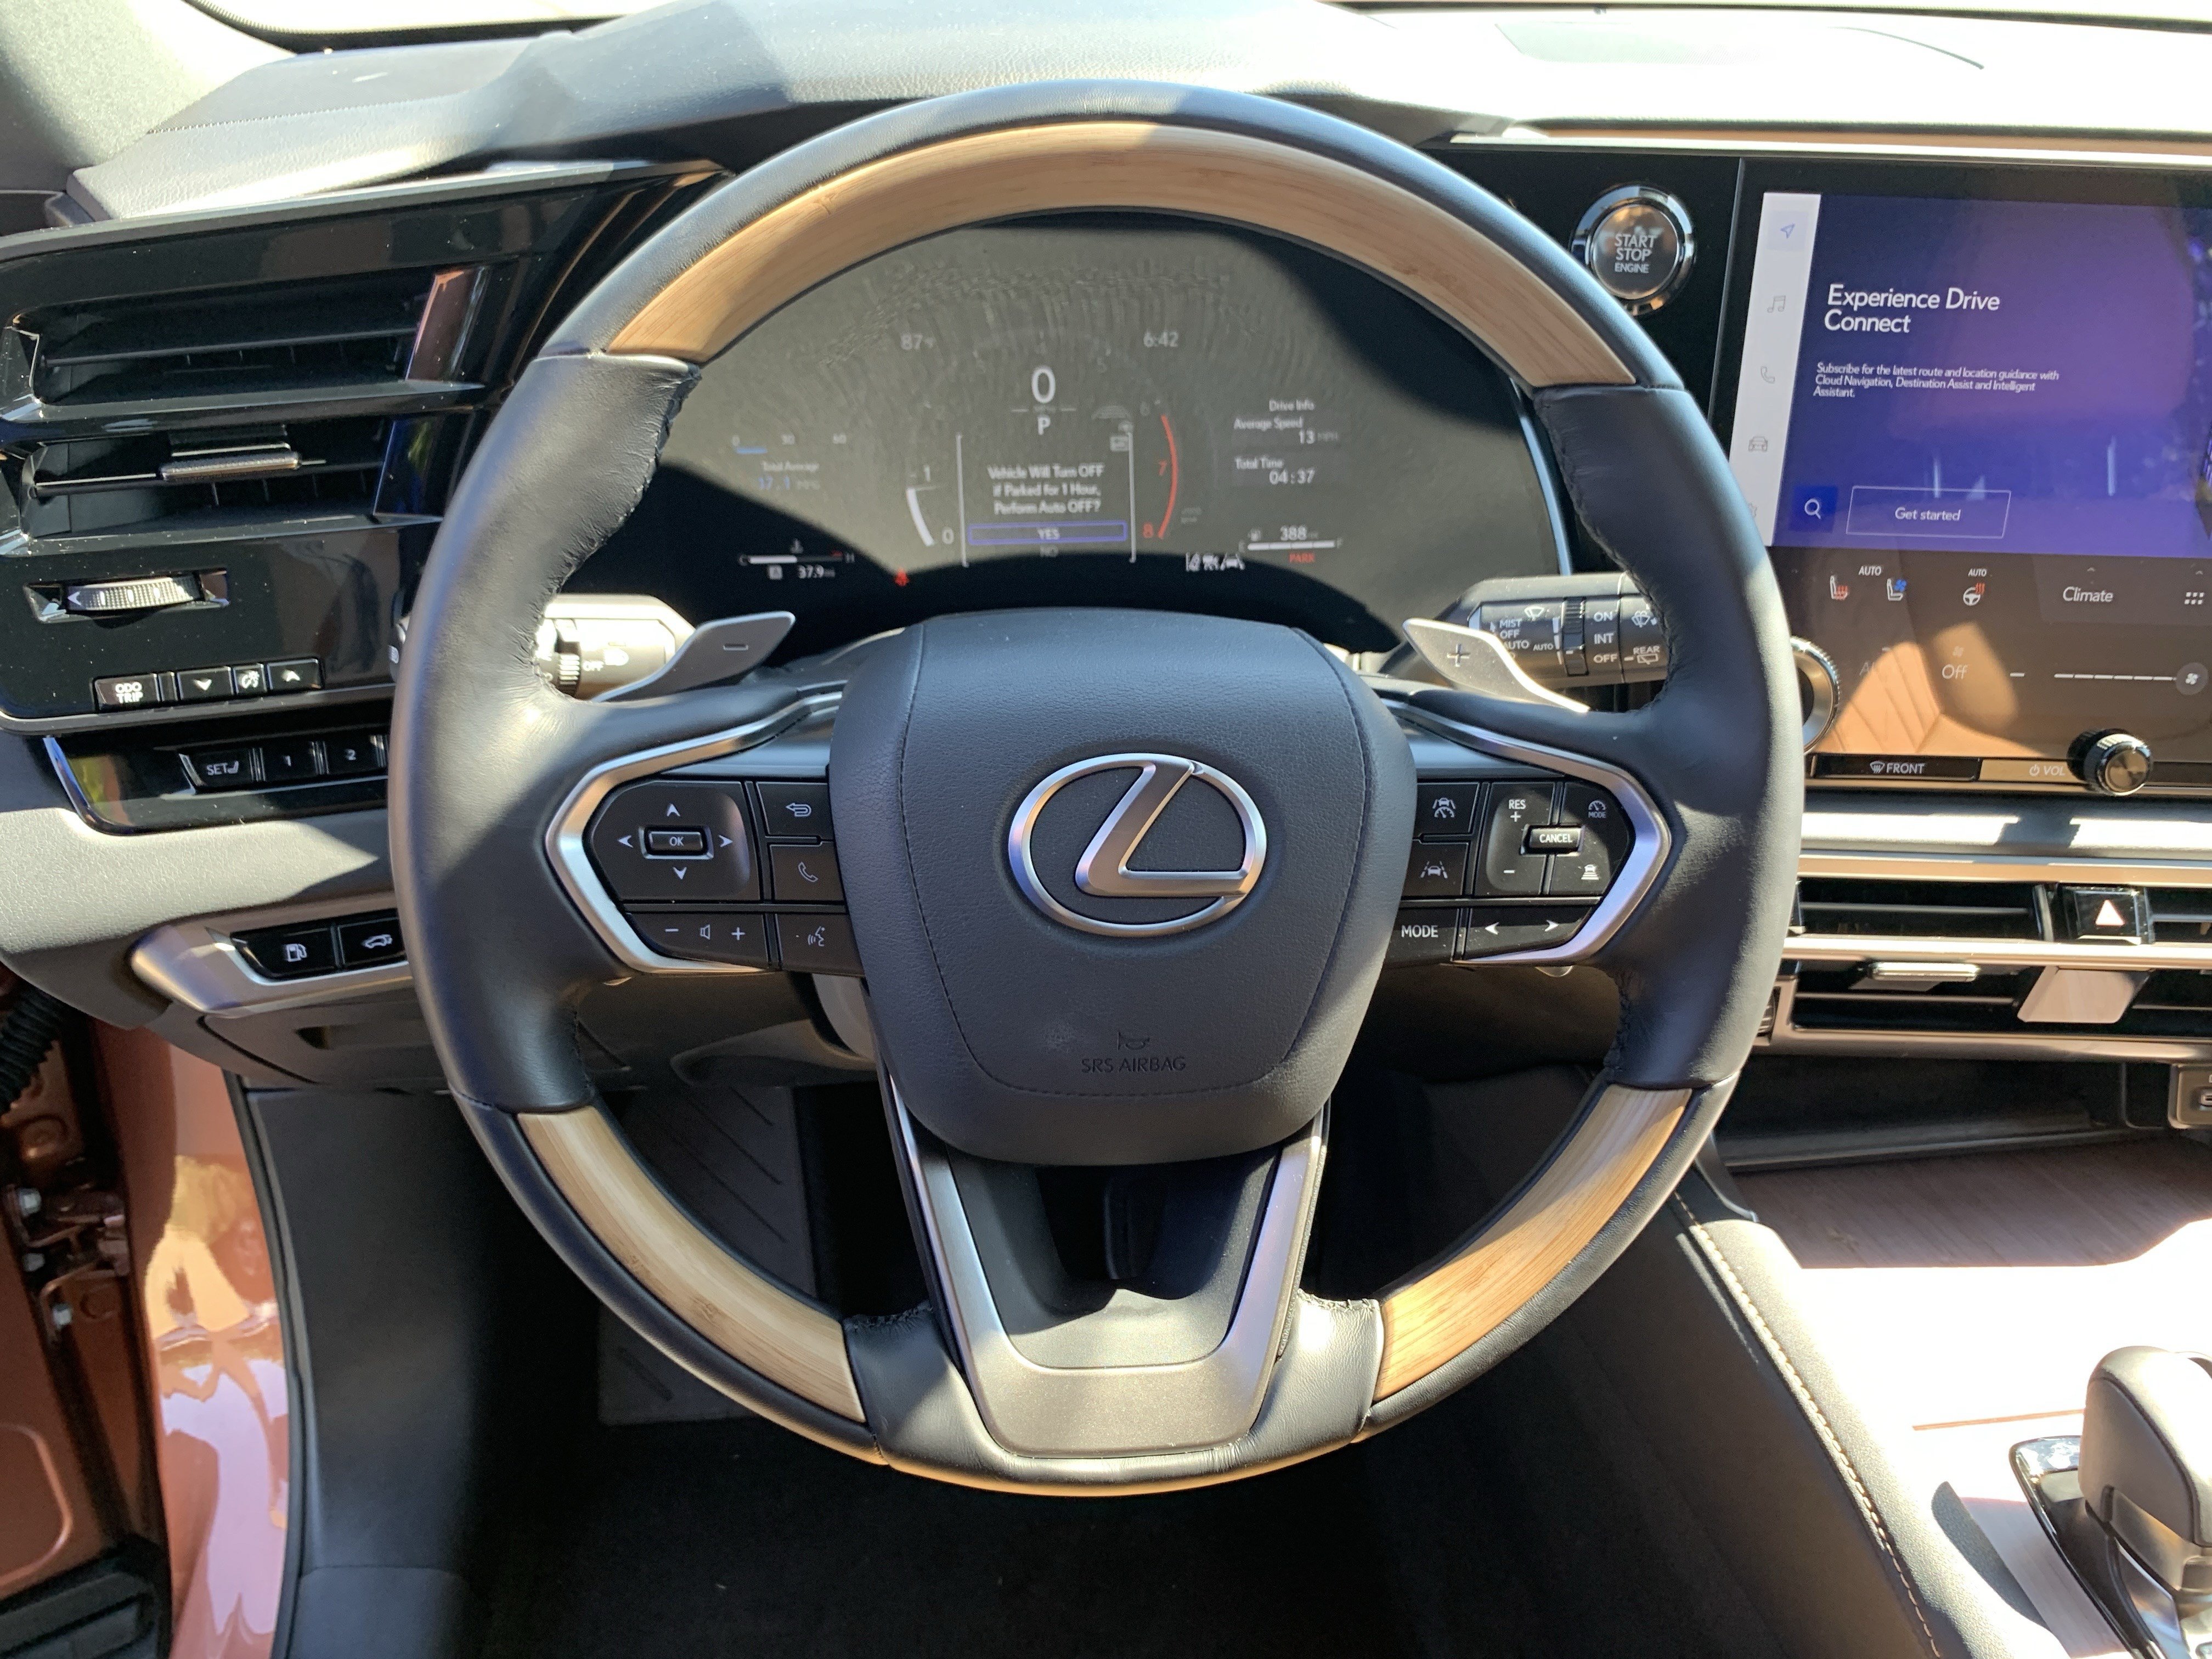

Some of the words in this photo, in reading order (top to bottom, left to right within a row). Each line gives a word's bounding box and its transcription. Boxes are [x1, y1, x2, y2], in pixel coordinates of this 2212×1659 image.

[1615, 234, 1655, 248] START
[1616, 248, 1651, 261] STOP
[1614, 263, 1650, 273] ENGINE
[1827, 284, 1940, 311] Experience
[1946, 287, 2000, 311] Drive
[1824, 308, 1911, 333] Connect
[1143, 331, 1179, 348] 6:42
[1816, 362, 1860, 374] Subscribe
[1861, 363, 1874, 374] for
[1877, 364, 1891, 375] the
[1893, 365, 1916, 376] latest
[1918, 368, 1943, 377] route
[1944, 367, 1962, 377] and
[1962, 367, 1997, 379] location
[1999, 369, 2038, 381] guidance
[2040, 370, 2059, 380] with
[1031, 365, 1056, 403] 0
[1815, 374, 1843, 385] Cloud
[1844, 375, 1893, 388] Navigation,
[1895, 376, 1945, 388] Destination
[1947, 379, 1973, 389] Assist
[1975, 380, 1992, 390] and
[1993, 381, 2036, 393] Intelligent
[1813, 386, 1855, 398] Assistant.
[1269, 399, 1295, 411] Drive
[1296, 398, 1315, 411] Info
[1038, 415, 1051, 435] P
[1234, 417, 1272, 431] Average
[1274, 416, 1303, 431] Speed
[1299, 427, 1315, 444] 13
[1159, 459, 1167, 476] 7
[1235, 456, 1259, 470] Total
[1260, 455, 1285, 469] Time
[924, 465, 930, 481] 1
[988, 464, 1026, 479] Vehicle
[1028, 463, 1051, 478] Will
[1052, 463, 1077, 478] Turn
[1079, 462, 1105, 477] OFF
[1269, 468, 1315, 484] 04:37
[1003, 483, 1041, 496] Parked
[1043, 483, 1059, 495] for
[1062, 482, 1068, 496] 1
[994, 500, 1037, 515] Perform
[1039, 500, 1066, 514] Auto
[1068, 499, 1101, 513] OFF?
[1895, 506, 1917, 520] Get
[1920, 509, 1961, 521] started
[941, 527, 954, 544] 0
[1037, 528, 1060, 540] YES
[1142, 522, 1154, 539] 8
[1280, 526, 1307, 541] 388
[1289, 552, 1315, 563] PARK
[798, 565, 824, 579] 37.9
[1858, 566, 1882, 576] AUTO
[1968, 568, 1987, 577] AUTO
[2063, 586, 2114, 602] Climate
[1499, 618, 1522, 628] MIST
[1593, 612, 1613, 622] ON
[1500, 629, 1520, 639] OFF
[1594, 633, 1613, 645] INT
[1503, 640, 1530, 650] AUTO
[1533, 642, 1554, 651] AUTO
[1633, 646, 1660, 655] REAR
[1593, 653, 1618, 663] OFF
[1942, 664, 1969, 679] Off
[115, 682, 142, 693] ODO
[116, 691, 143, 703] TRIP
[284, 755, 291, 767] 1
[345, 749, 356, 760] 2
[207, 763, 228, 775] SET
[1886, 763, 1925, 774] FRONT
[2043, 765, 2066, 776] VOL
[1508, 799, 1526, 810] RES
[669, 836, 685, 847] OK
[1539, 833, 1573, 843] CANCEL
[1401, 925, 1439, 938] MODE
[1081, 1058, 1114, 1073] SRS
[1119, 1056, 1187, 1073] AIRBAG
